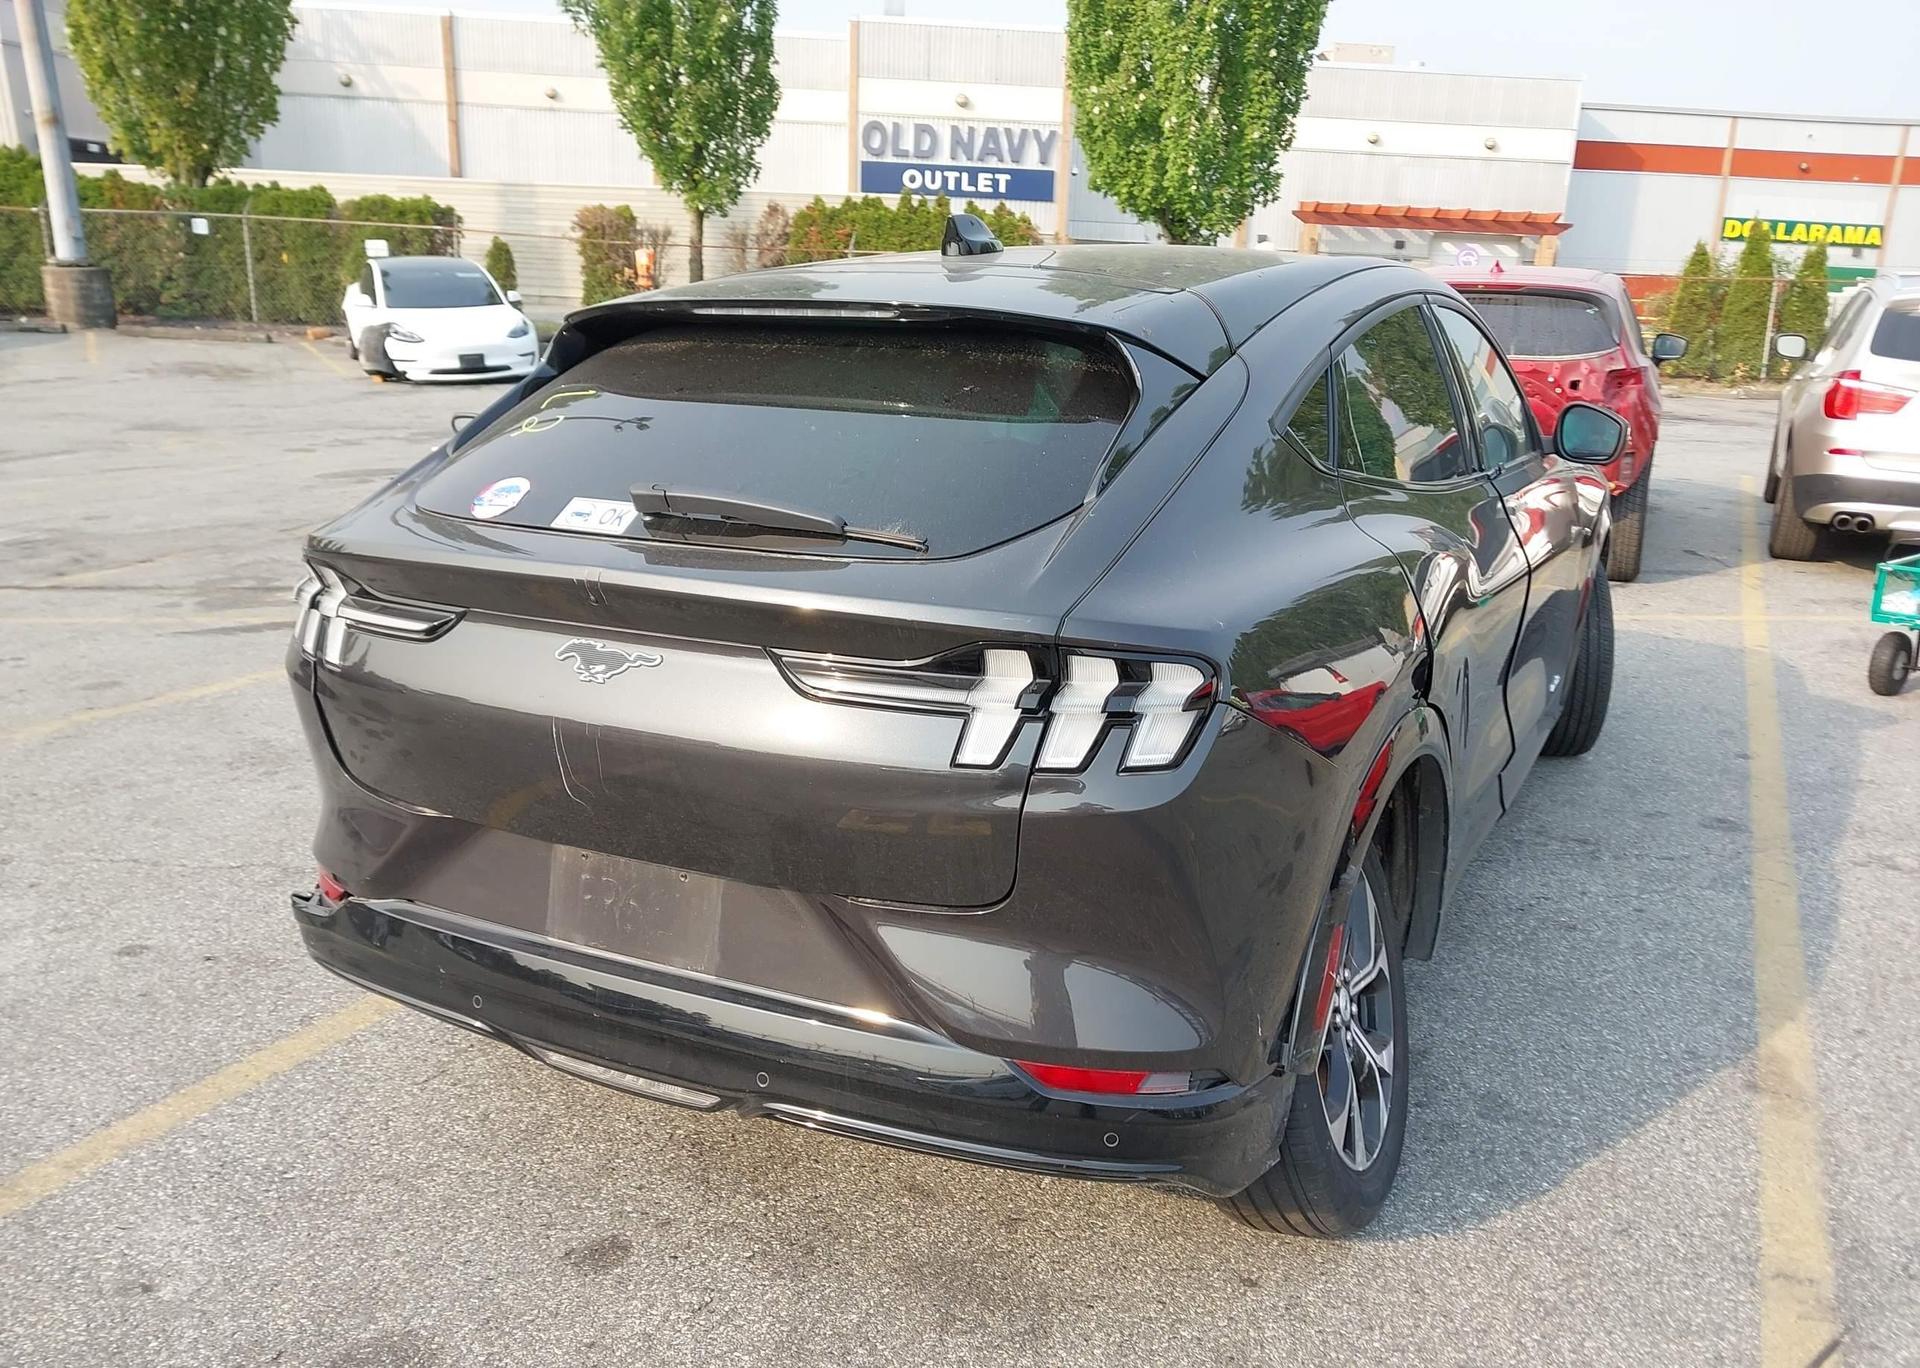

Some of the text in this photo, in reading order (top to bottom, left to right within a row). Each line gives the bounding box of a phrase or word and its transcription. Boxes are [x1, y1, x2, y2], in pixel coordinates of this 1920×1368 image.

[862, 120, 1057, 164] OLD NAVY
[902, 168, 1012, 193] OUTLET
